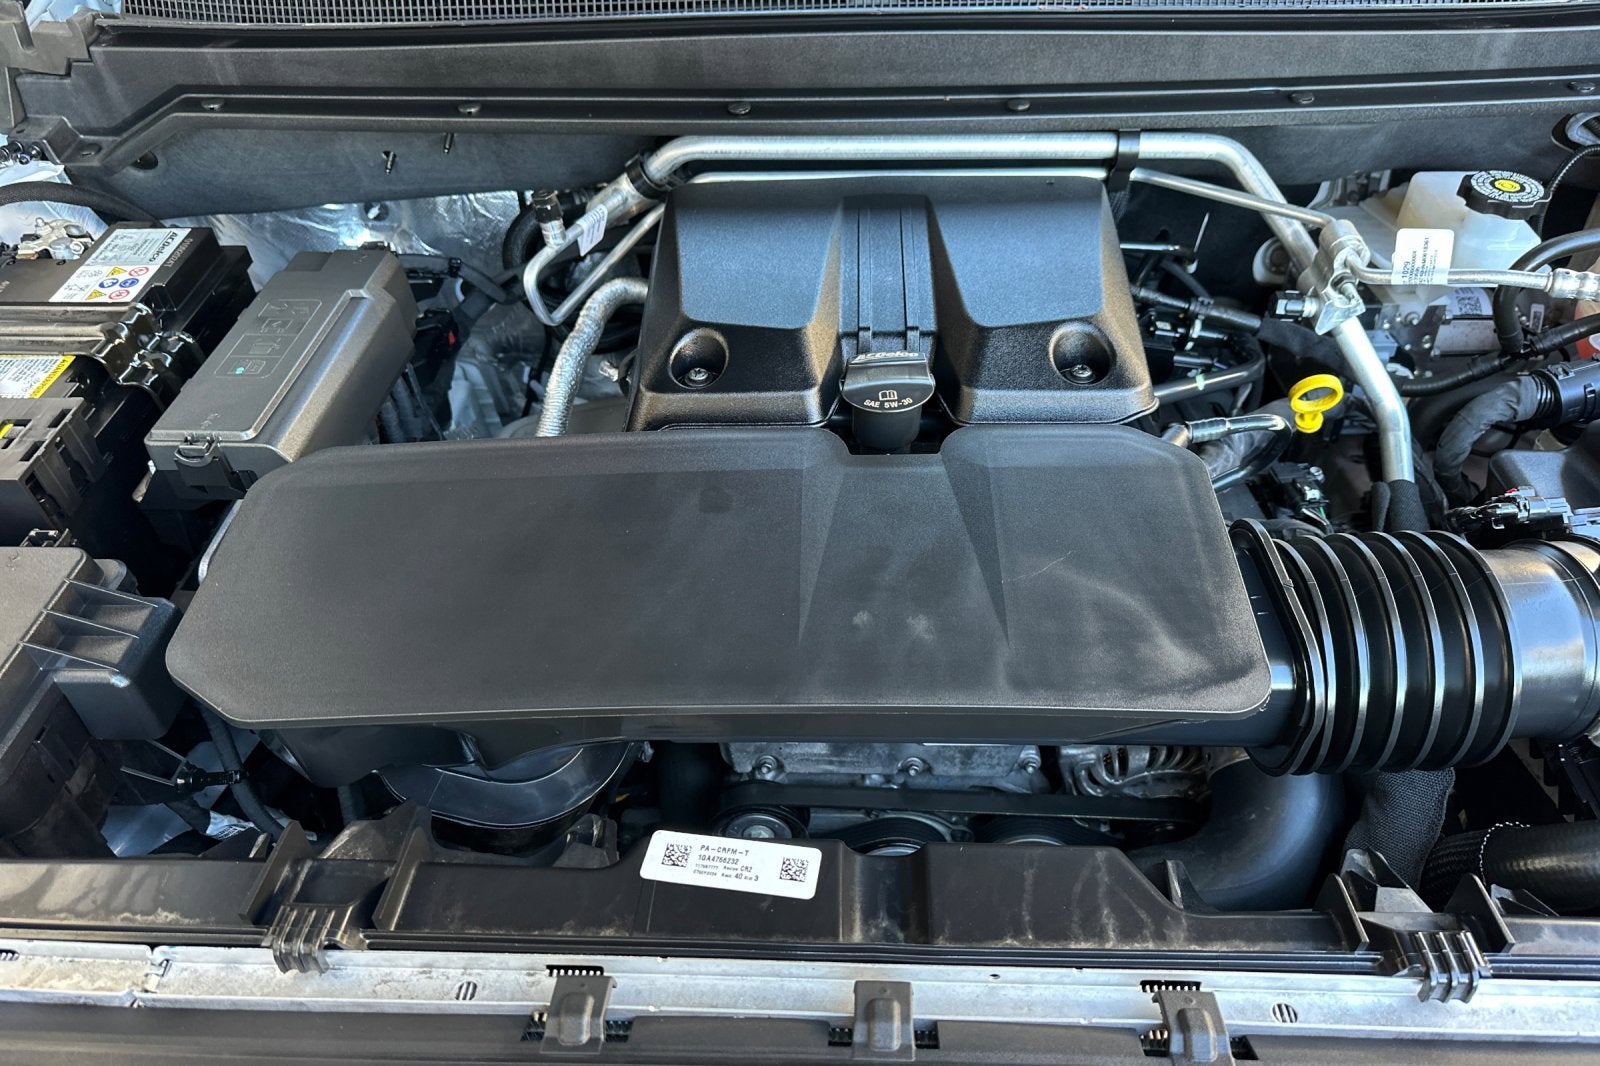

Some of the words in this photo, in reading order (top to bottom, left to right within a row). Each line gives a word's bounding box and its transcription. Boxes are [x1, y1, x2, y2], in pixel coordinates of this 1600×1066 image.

[148, 231, 178, 262] ACDelco
[852, 351, 919, 363] ACDelco
[863, 399, 881, 408] SAE
[884, 397, 913, 408] 5W-30
[740, 865, 753, 873] CR2
[734, 872, 744, 880] 40
[754, 874, 759, 882] 3
